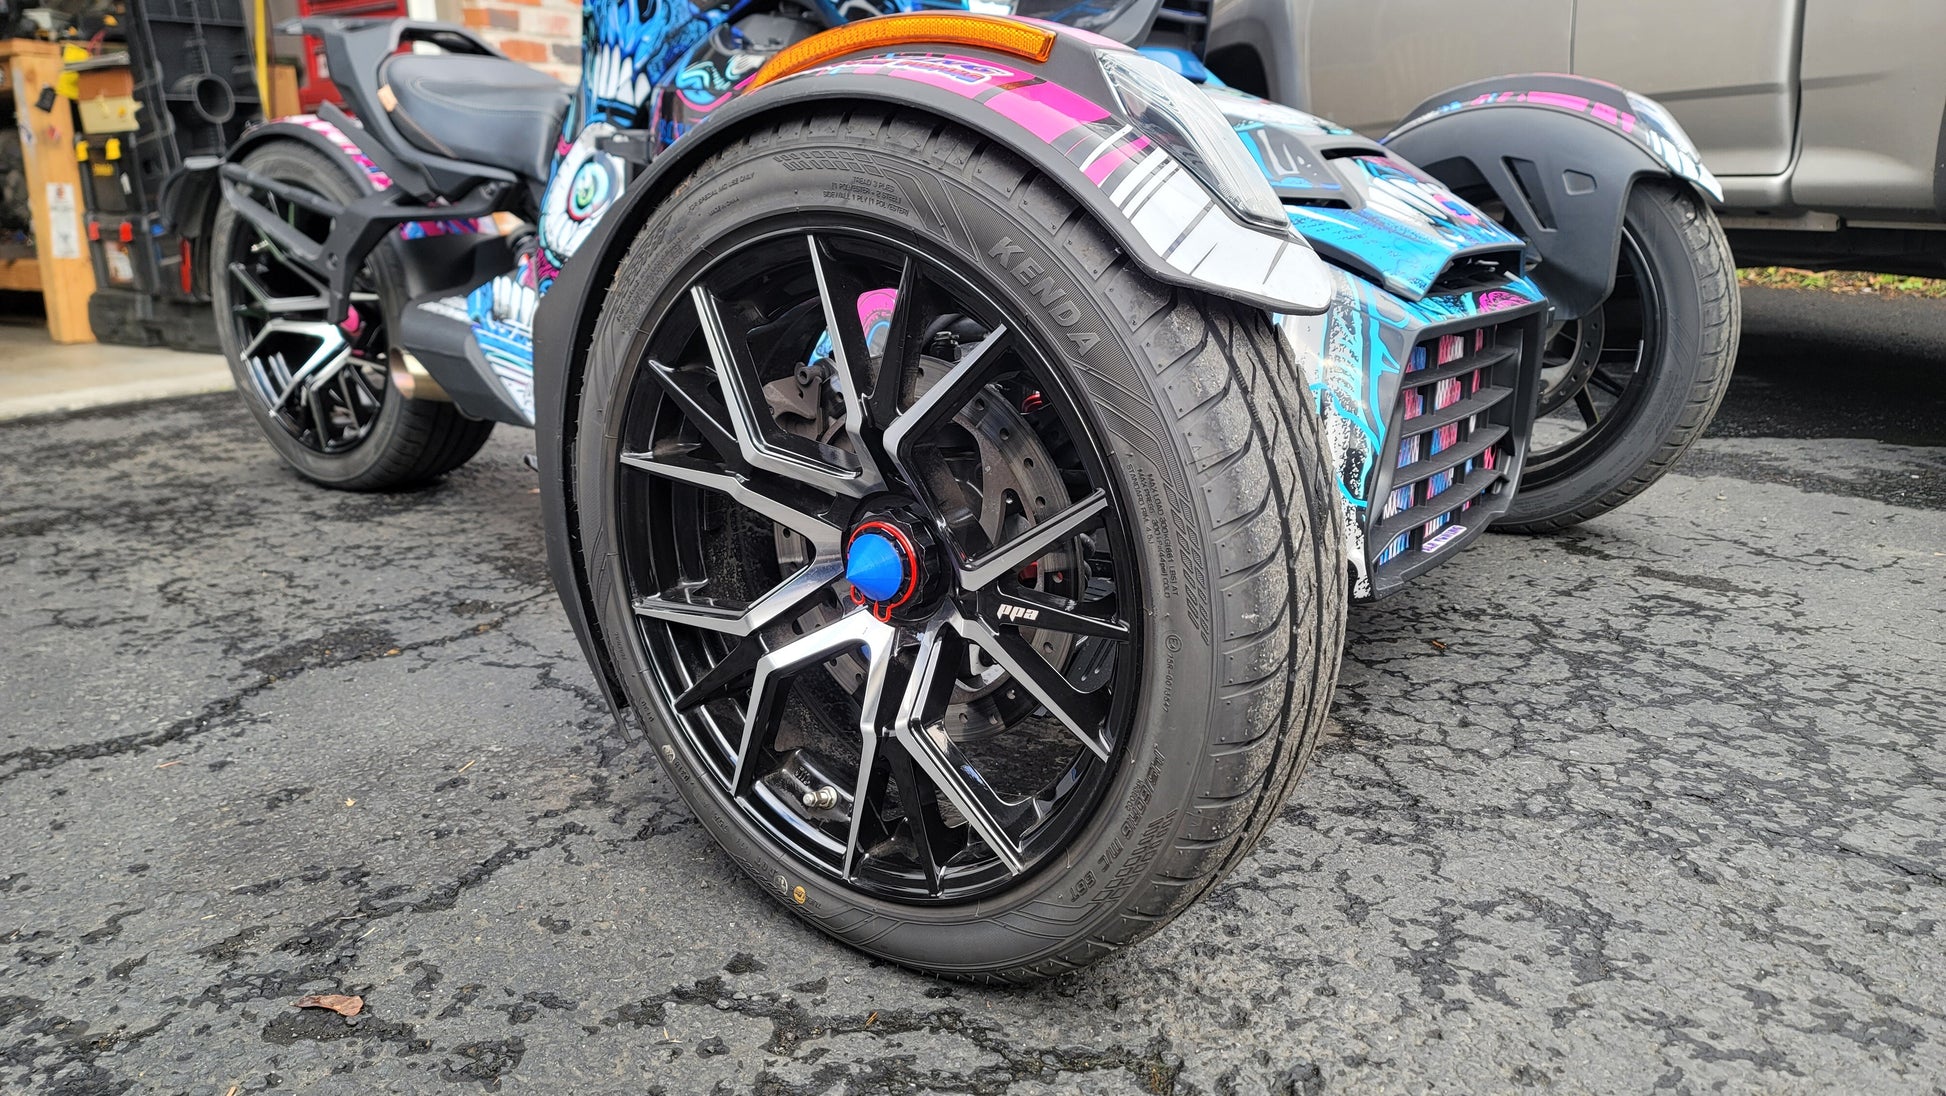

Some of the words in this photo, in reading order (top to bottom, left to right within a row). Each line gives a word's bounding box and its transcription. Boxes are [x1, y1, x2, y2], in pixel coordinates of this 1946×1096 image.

[988, 236, 1100, 357] KENDA
[1127, 463, 1143, 505] STANDARD
[1147, 473, 1157, 492] MAX
[1153, 493, 1164, 515] LOAD
[1070, 869, 1097, 902] 66T
